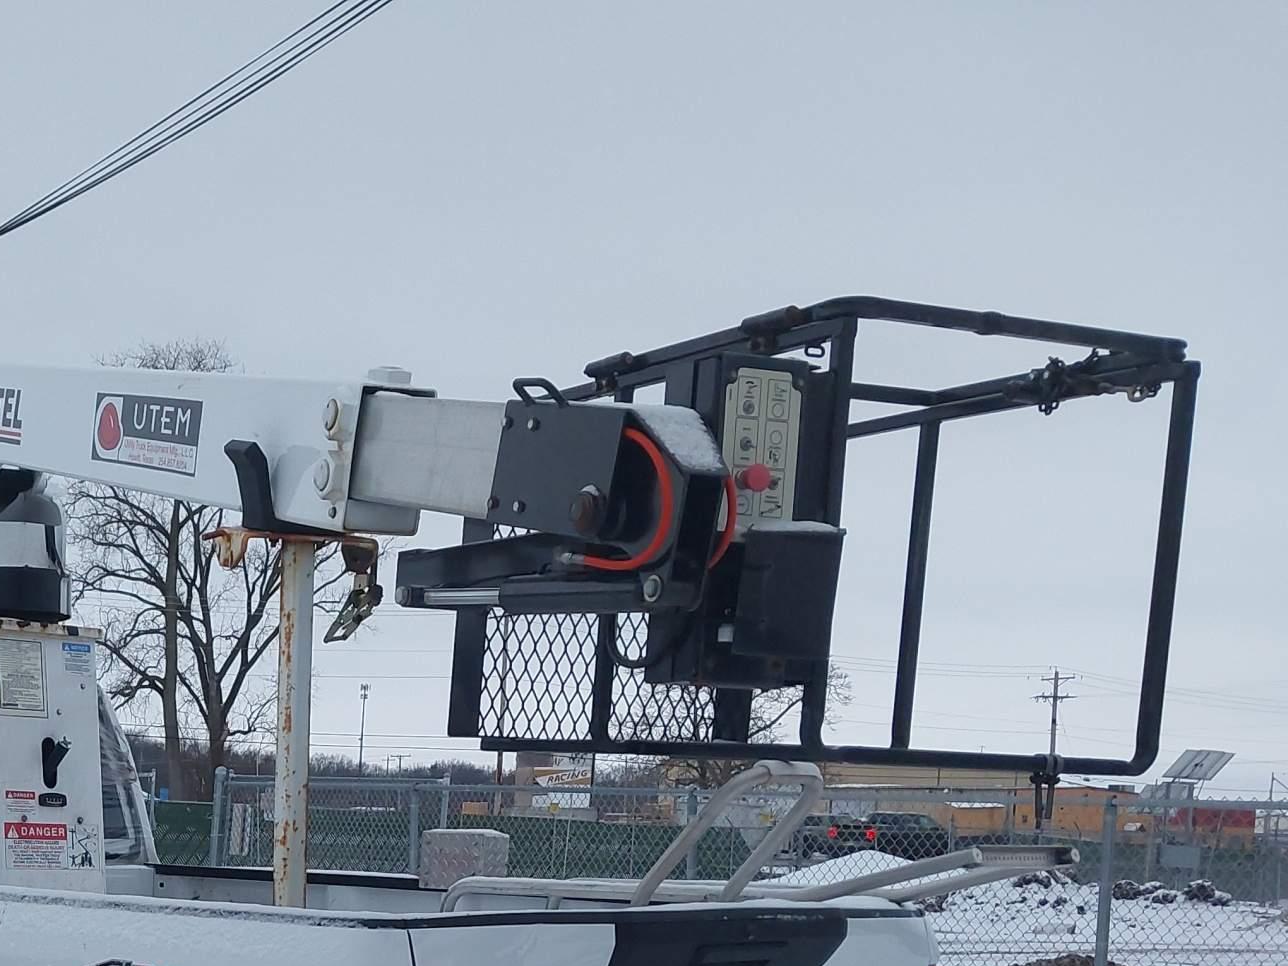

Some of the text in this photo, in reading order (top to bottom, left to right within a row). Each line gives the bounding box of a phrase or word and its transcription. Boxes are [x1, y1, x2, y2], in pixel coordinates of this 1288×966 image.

[134, 403, 191, 437] UTEM
[547, 769, 588, 785] RACING
[21, 826, 65, 837] DANGER
